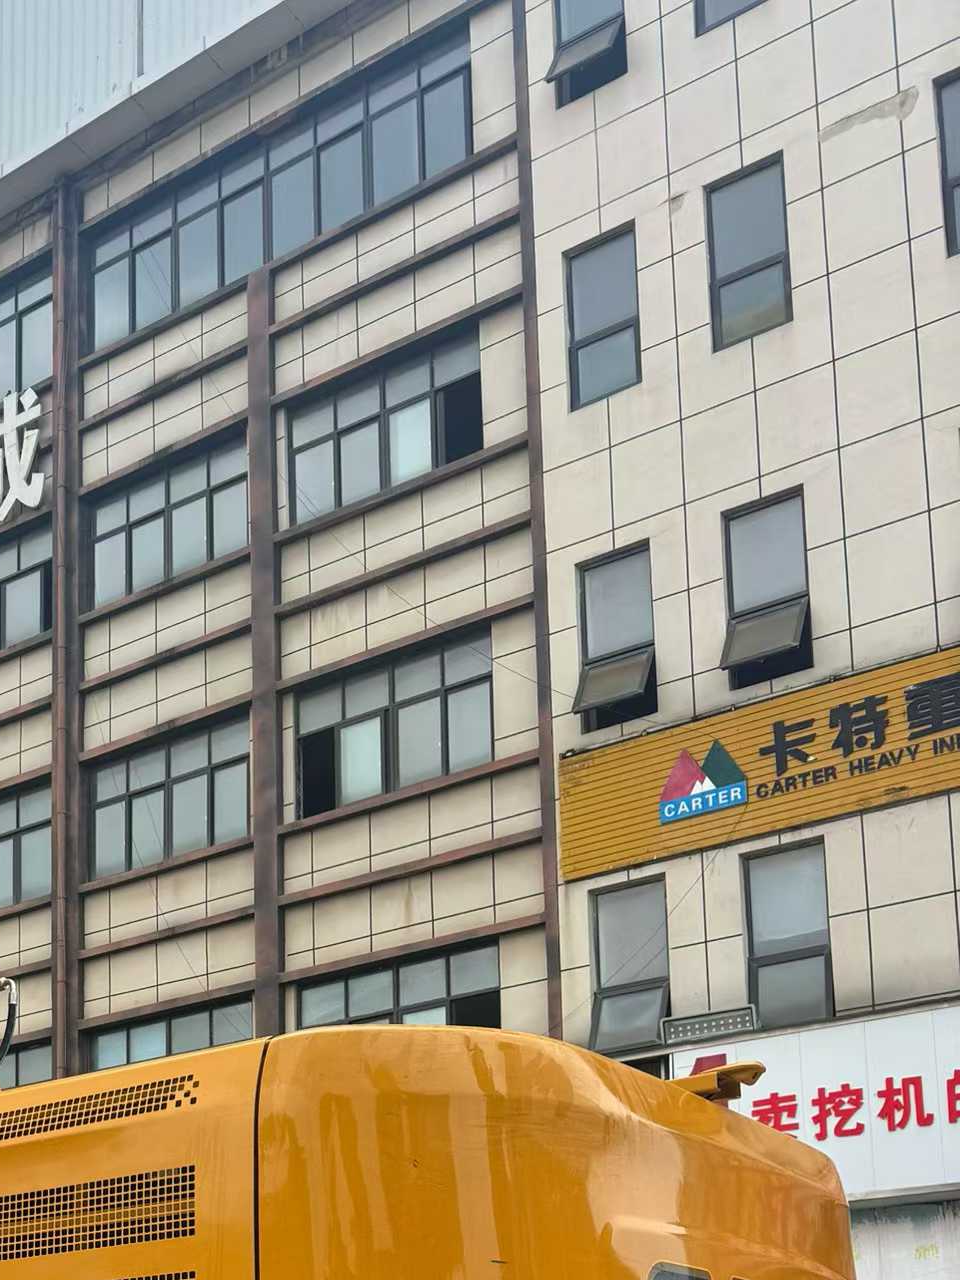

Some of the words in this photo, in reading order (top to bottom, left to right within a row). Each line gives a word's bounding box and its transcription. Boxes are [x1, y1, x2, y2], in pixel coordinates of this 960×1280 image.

[755, 765, 838, 799] CARTER
[848, 743, 920, 776] HEAVY
[663, 786, 742, 818] CARTER
